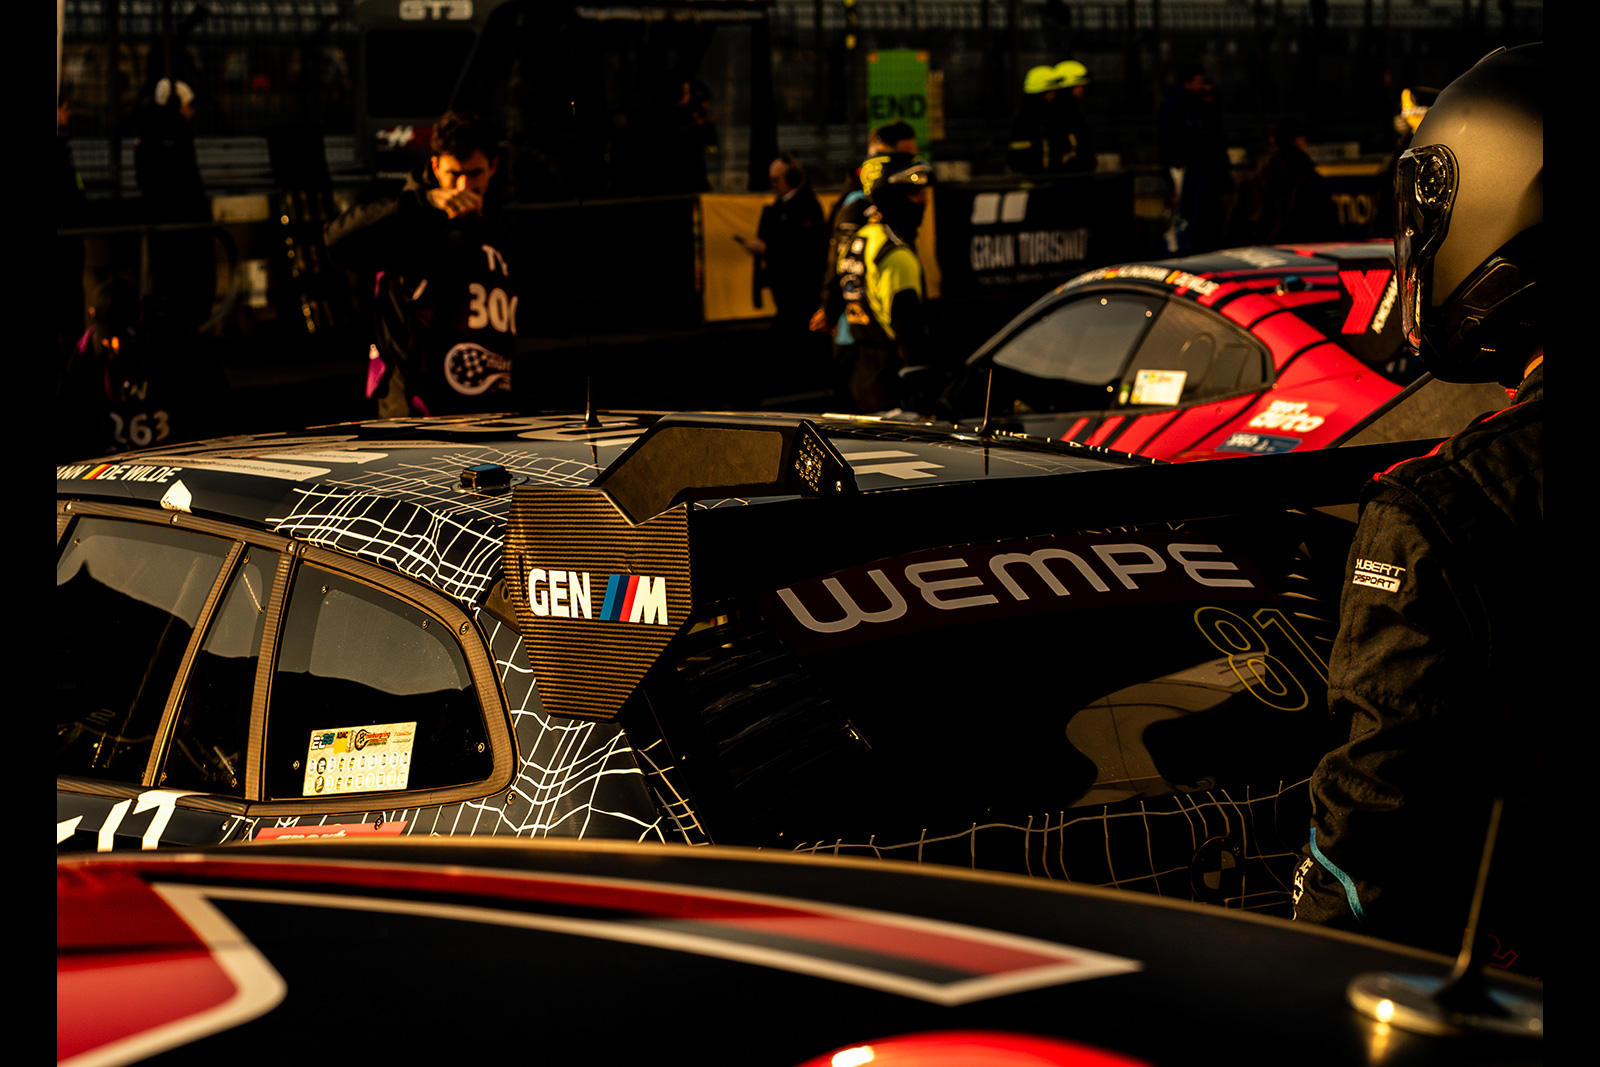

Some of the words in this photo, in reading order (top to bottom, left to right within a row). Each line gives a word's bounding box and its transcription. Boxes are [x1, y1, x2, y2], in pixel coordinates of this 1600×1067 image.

[399, 0, 473, 21] GT3
[869, 94, 927, 118] END
[969, 233, 1016, 271] GRAN
[1018, 227, 1088, 266] TURISMO
[109, 409, 171, 447] 263
[96, 464, 132, 480] DE
[121, 465, 182, 483] WILDE
[528, 568, 592, 619] GEN
[777, 543, 1255, 634] WEMPE
[1194, 606, 1329, 711] 81
[336, 731, 349, 739] ADAC
